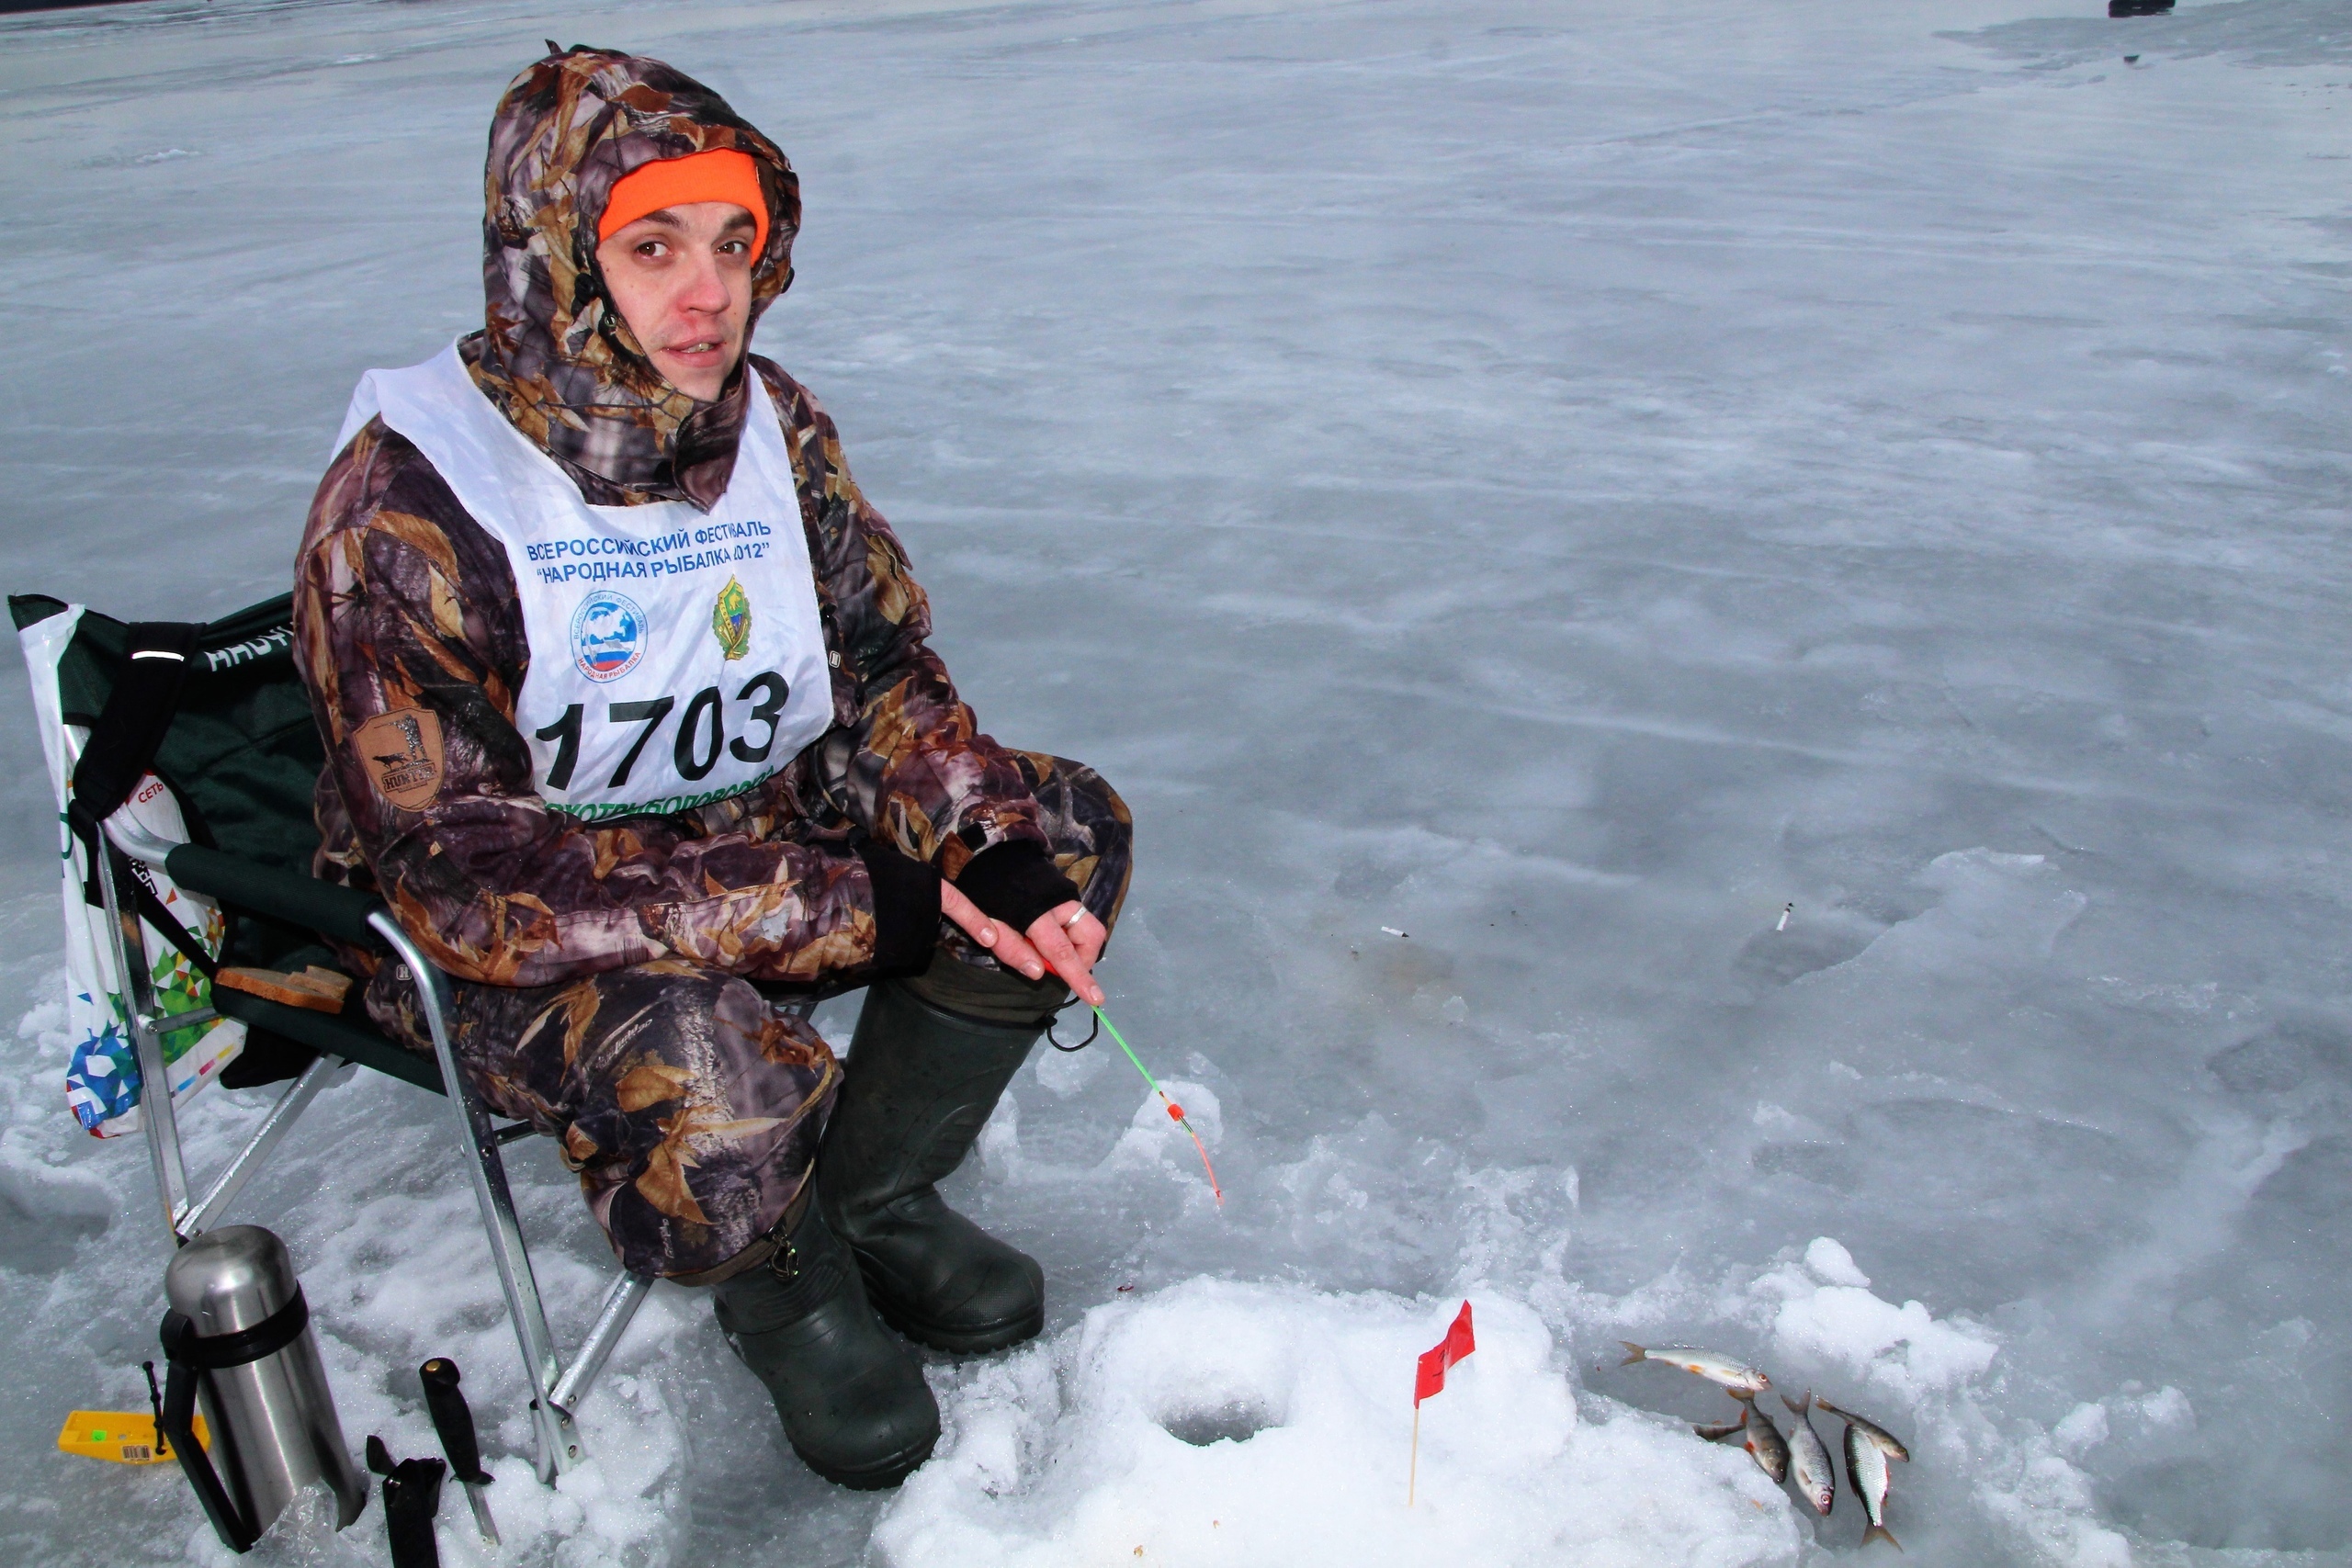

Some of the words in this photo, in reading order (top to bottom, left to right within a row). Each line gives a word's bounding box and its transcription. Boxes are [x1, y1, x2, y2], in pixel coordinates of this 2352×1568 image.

[526, 528, 691, 561] ВСЕРОССИЙСКИЙ
[695, 521, 772, 545] ФЕСТИВАЛЬ
[650, 547, 732, 578] РЫБАЛКА
[578, 657, 608, 680] НАРОДНАЯ
[609, 651, 641, 678] РЫБАЛКА
[536, 671, 790, 791] 1703
[138, 782, 164, 804] СЕТЬ
